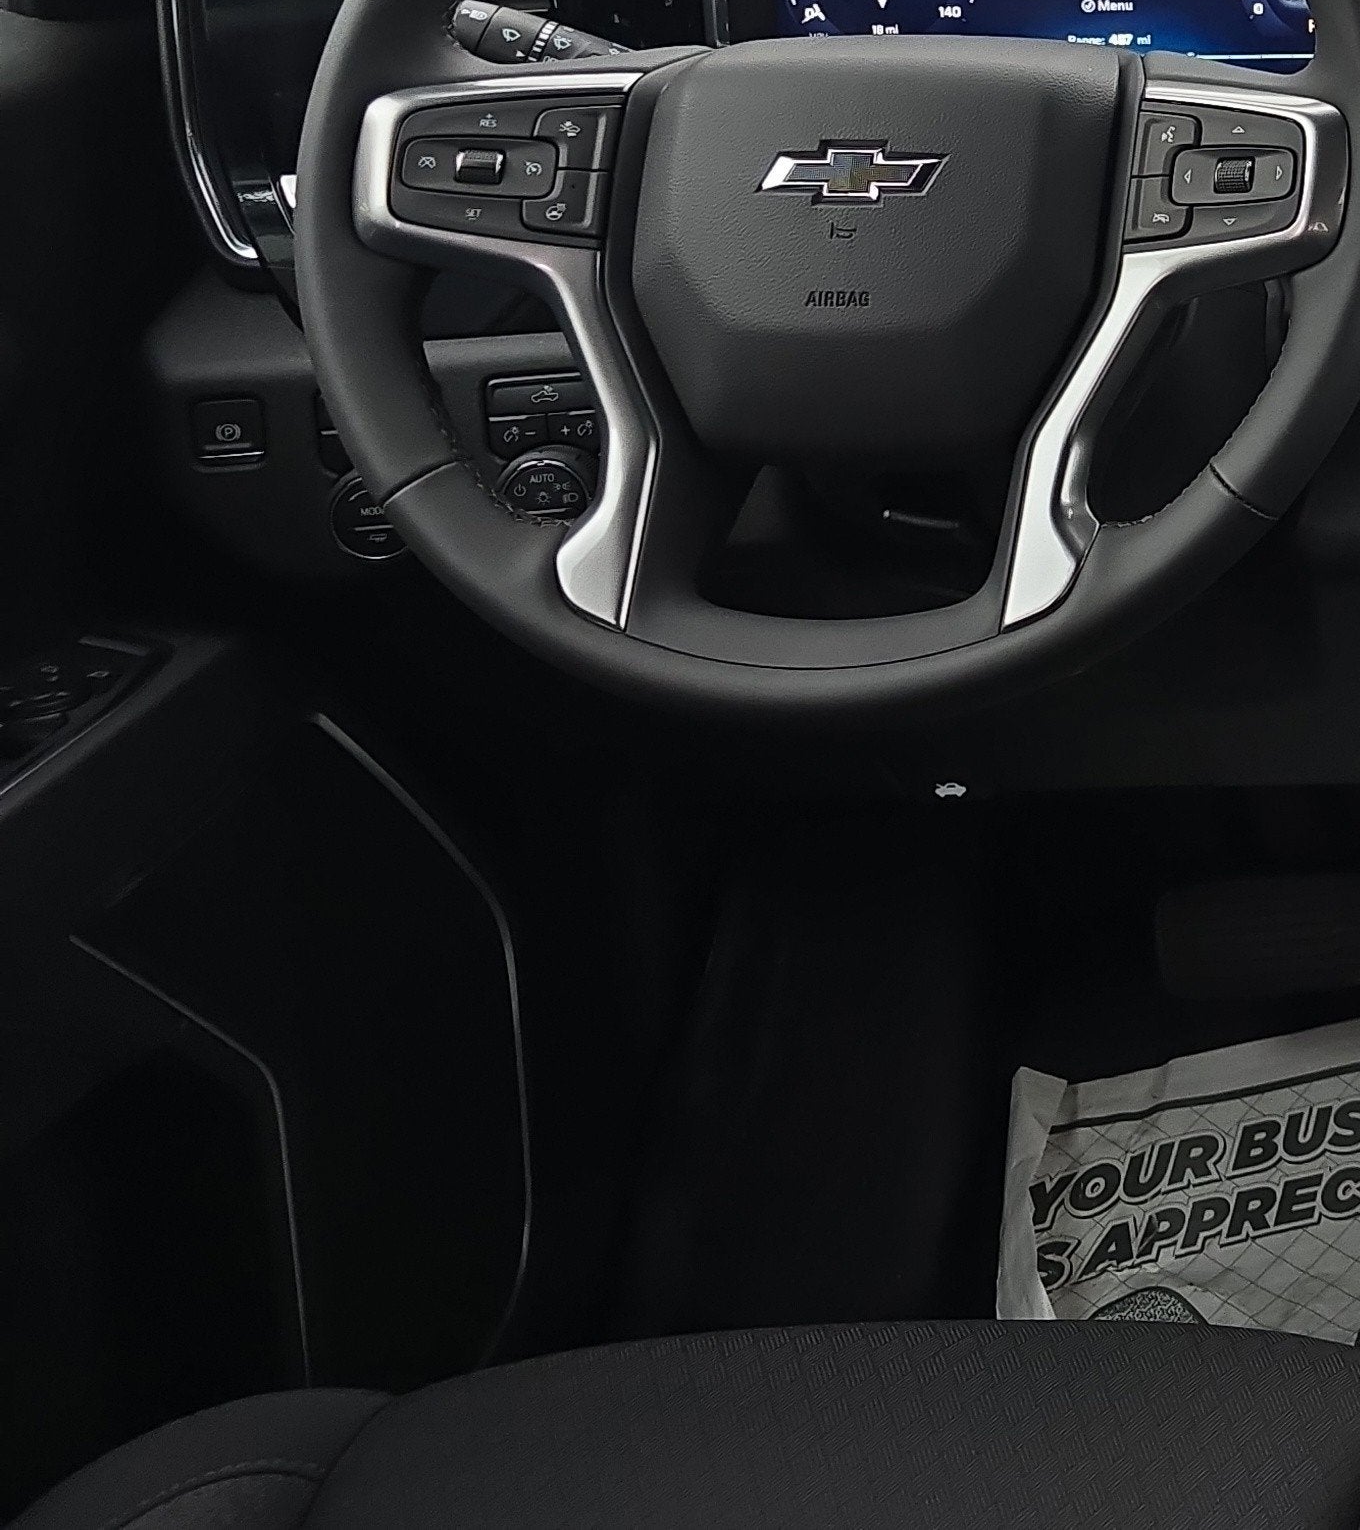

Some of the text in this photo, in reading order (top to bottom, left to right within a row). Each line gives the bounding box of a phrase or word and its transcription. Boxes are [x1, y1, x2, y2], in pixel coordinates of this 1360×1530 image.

[1098, 0, 1134, 12] Menu
[1253, 3, 1264, 15] 0
[938, 6, 961, 18] 140
[885, 25, 898, 35] mi
[1136, 34, 1152, 45] mi
[479, 119, 498, 128] RES
[465, 207, 482, 218] SET
[804, 289, 871, 308] AIRBAG
[529, 473, 555, 484] AUTO
[360, 505, 386, 516] MOD
[1029, 1130, 1224, 1227] YOUR
[1034, 1239, 1071, 1289] S
